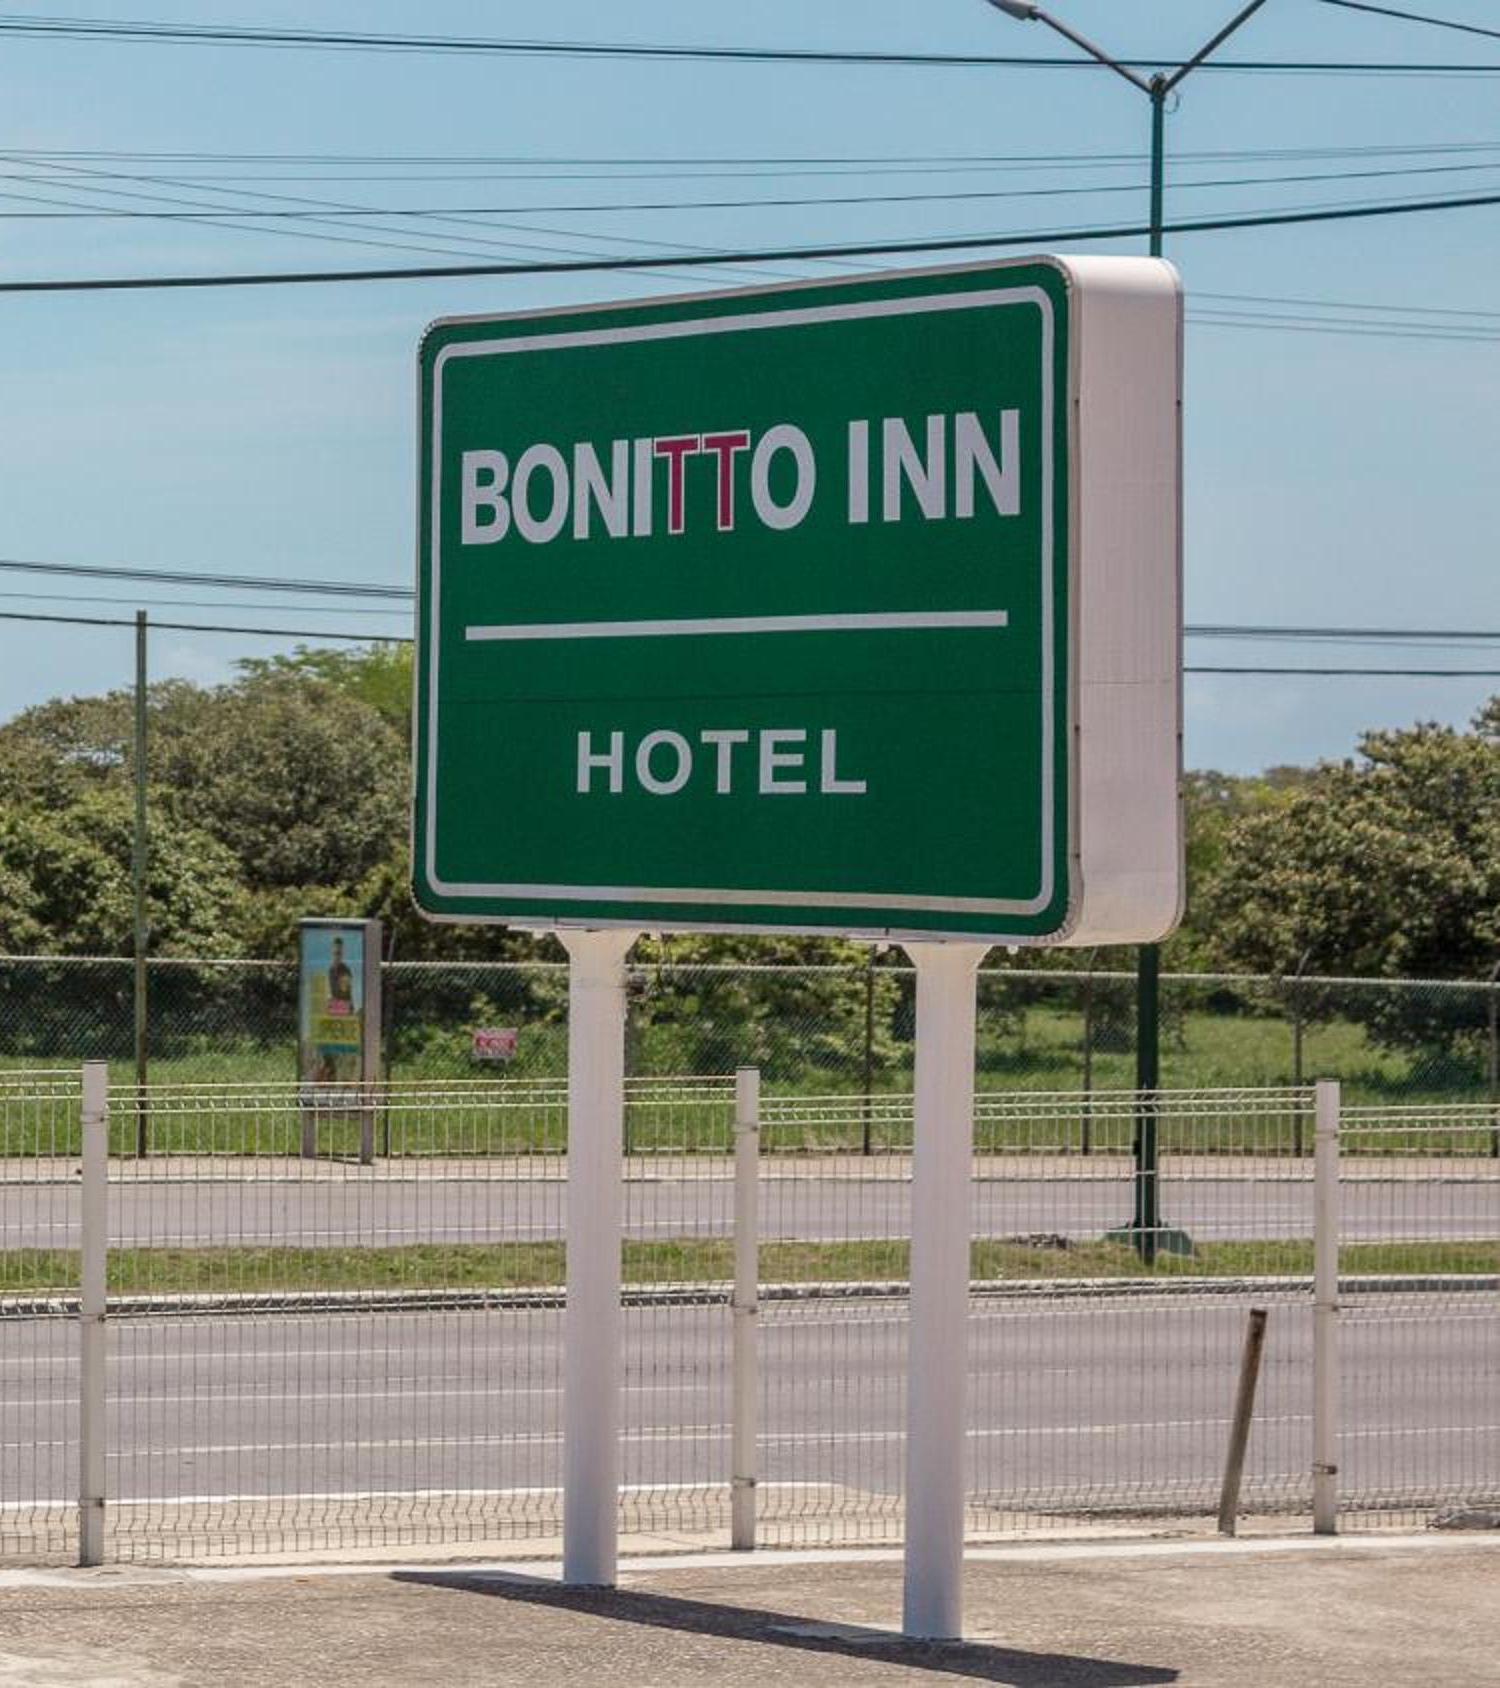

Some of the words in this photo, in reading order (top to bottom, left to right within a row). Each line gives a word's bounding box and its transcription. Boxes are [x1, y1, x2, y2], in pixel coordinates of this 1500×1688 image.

[462, 424, 816, 545] BONITTO
[848, 409, 1020, 523] INN
[577, 729, 867, 794] HOTEL
